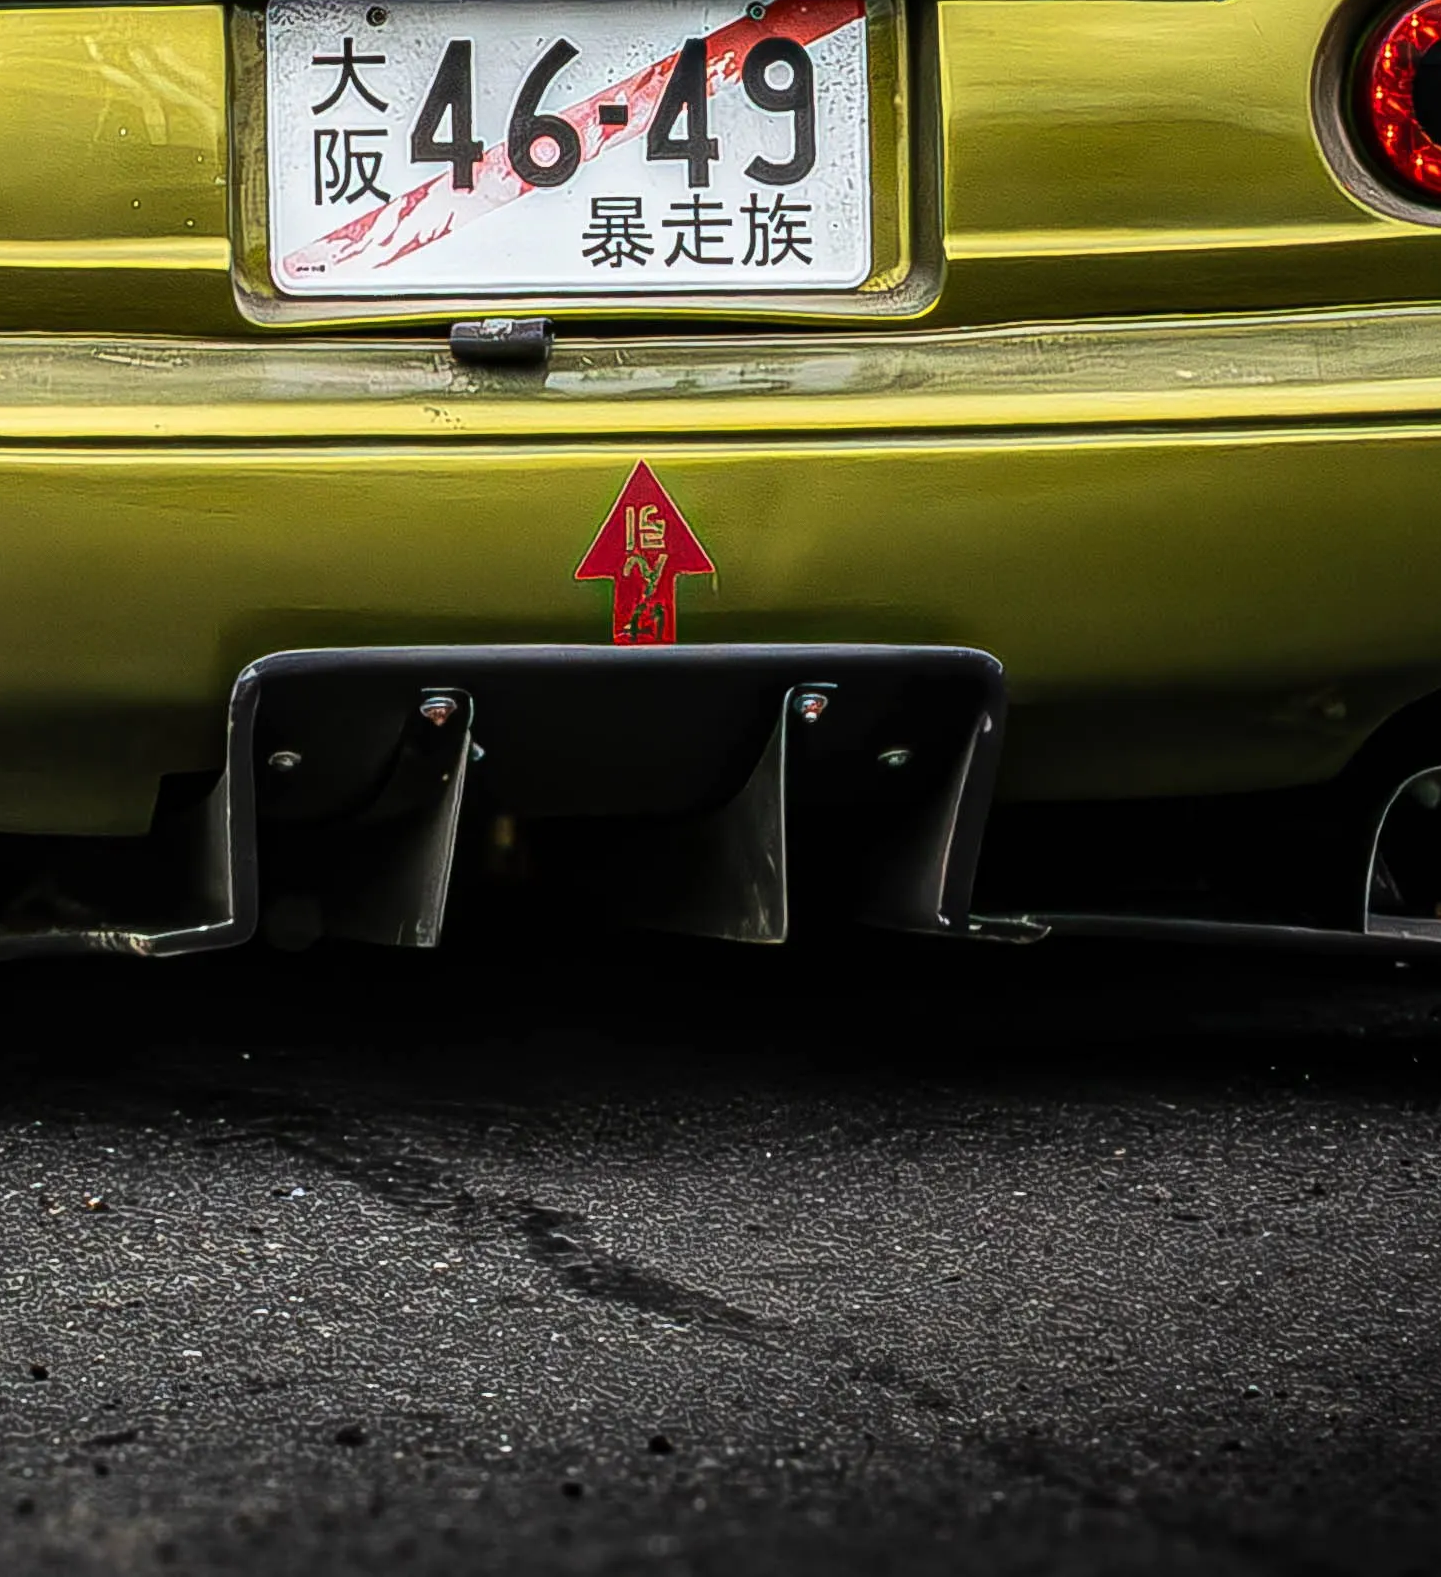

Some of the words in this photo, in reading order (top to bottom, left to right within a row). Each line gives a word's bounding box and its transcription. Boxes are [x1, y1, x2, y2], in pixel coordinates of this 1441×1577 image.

[310, 35, 391, 206] 大阪
[409, 36, 815, 190] 46-49
[582, 191, 814, 268] 暴走族
